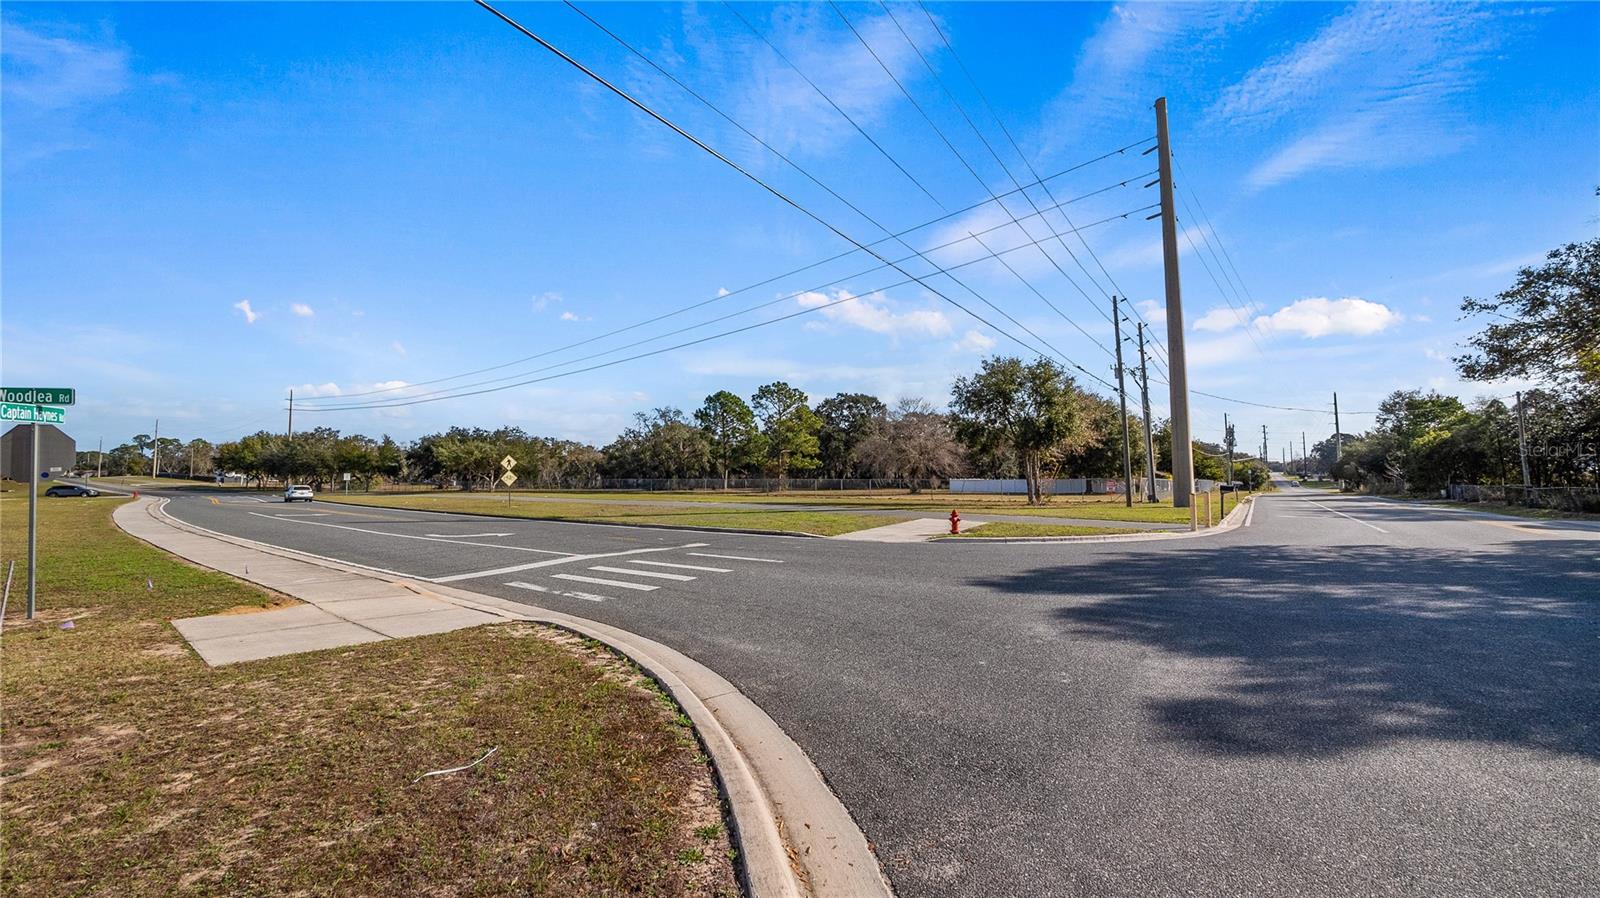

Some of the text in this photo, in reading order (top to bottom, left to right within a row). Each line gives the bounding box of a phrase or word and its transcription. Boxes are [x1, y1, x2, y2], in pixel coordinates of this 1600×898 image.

[59, 394, 69, 402] Rd
[1, 405, 31, 420] Captain
[33, 407, 58, 422] Haynes
